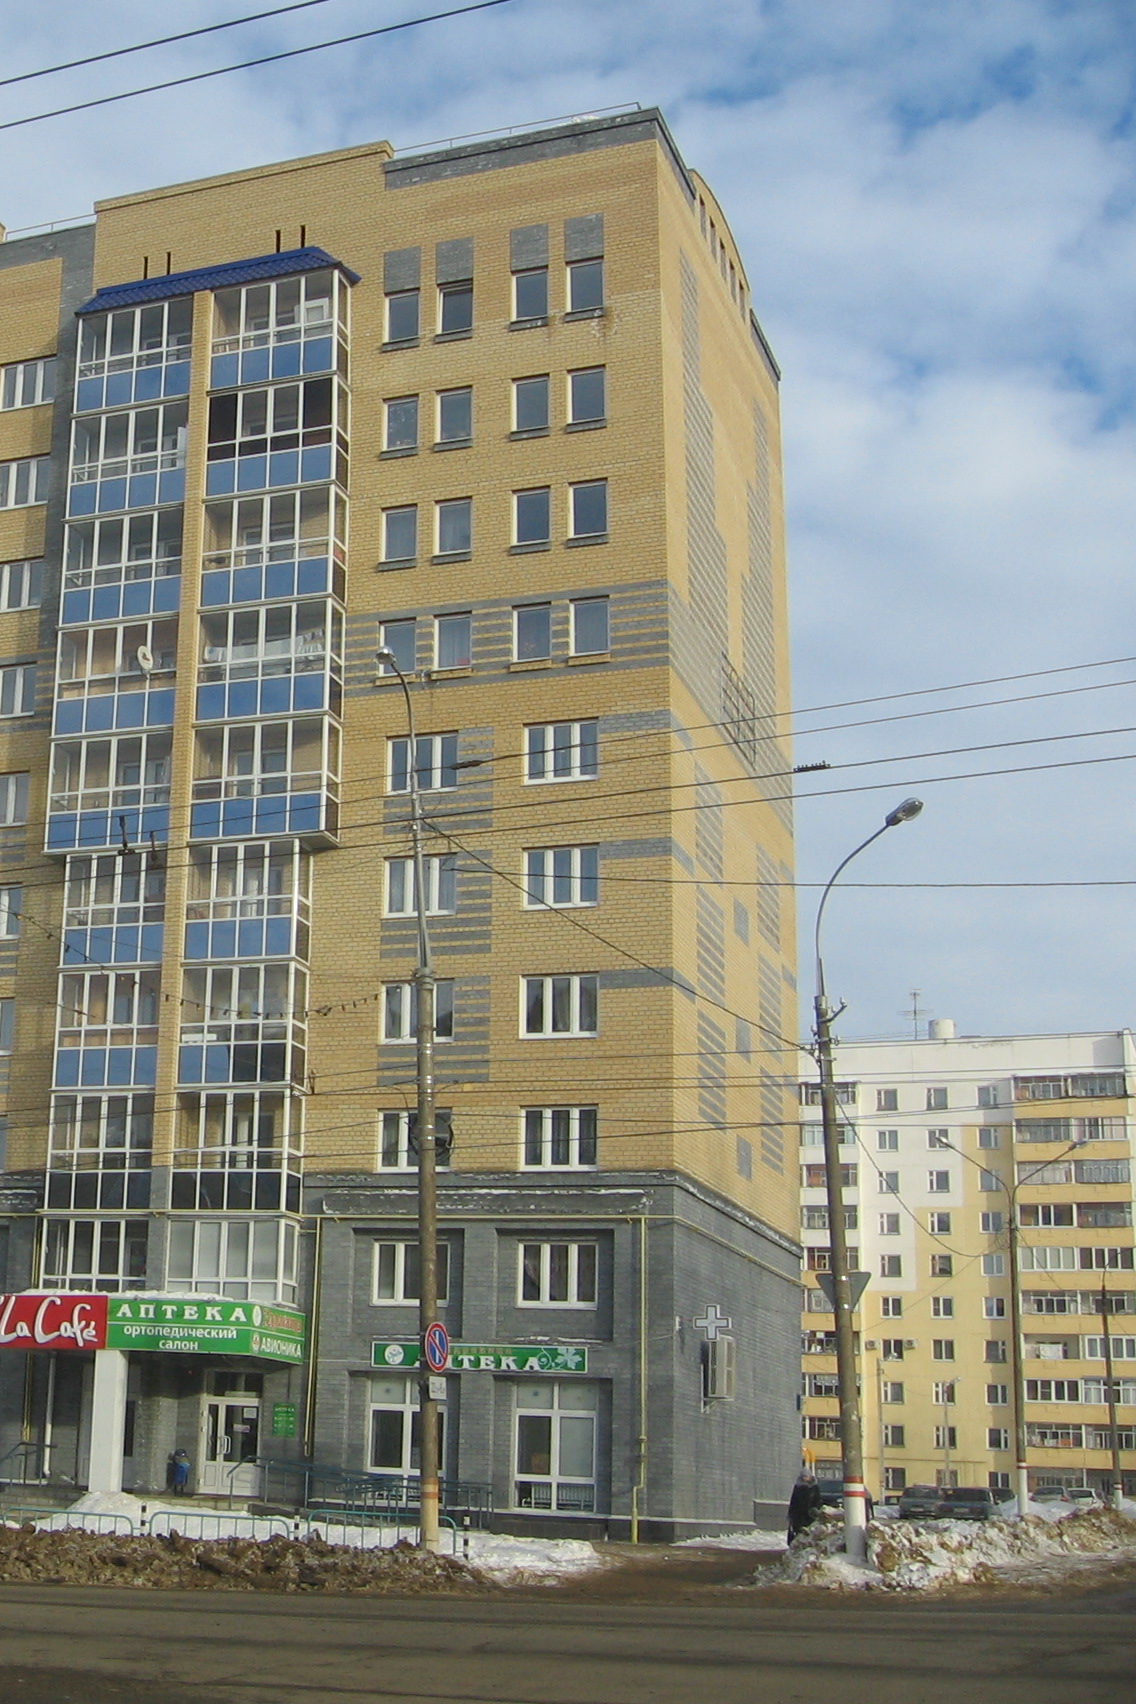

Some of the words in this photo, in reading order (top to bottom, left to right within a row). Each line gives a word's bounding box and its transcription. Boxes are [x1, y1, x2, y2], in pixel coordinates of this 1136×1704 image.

[33, 1296, 98, 1347] Café
[116, 1303, 247, 1322] АПТЕКА
[123, 1325, 238, 1340] ортопедический
[159, 1340, 199, 1350] салон
[260, 1337, 302, 1358] АВИОНИКА
